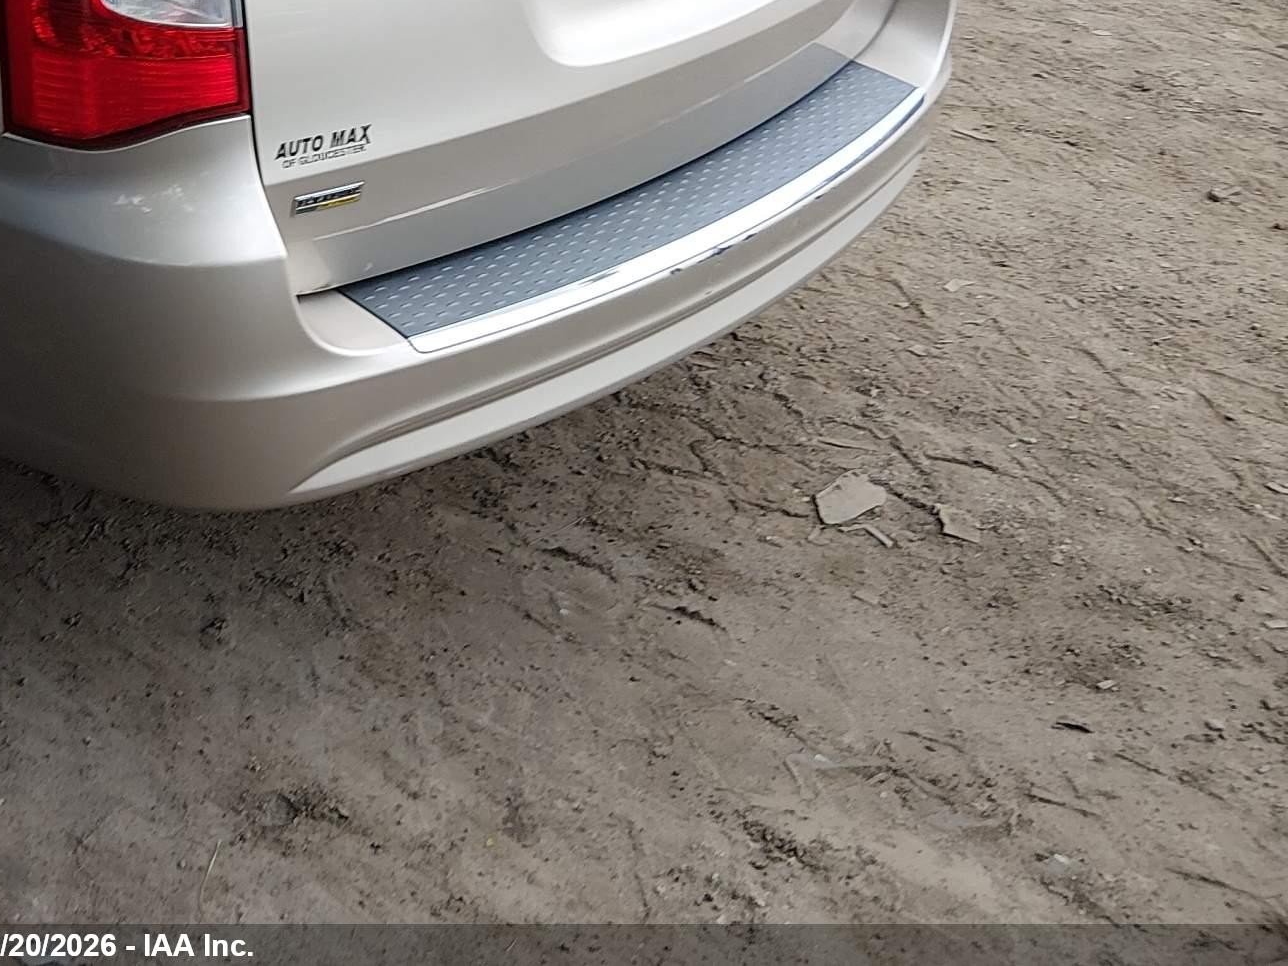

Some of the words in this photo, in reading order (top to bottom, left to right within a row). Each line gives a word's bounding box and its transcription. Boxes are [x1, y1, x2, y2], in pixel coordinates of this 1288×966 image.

[275, 135, 323, 159] AUTO
[330, 124, 372, 147] MAX
[282, 158, 296, 168] OF
